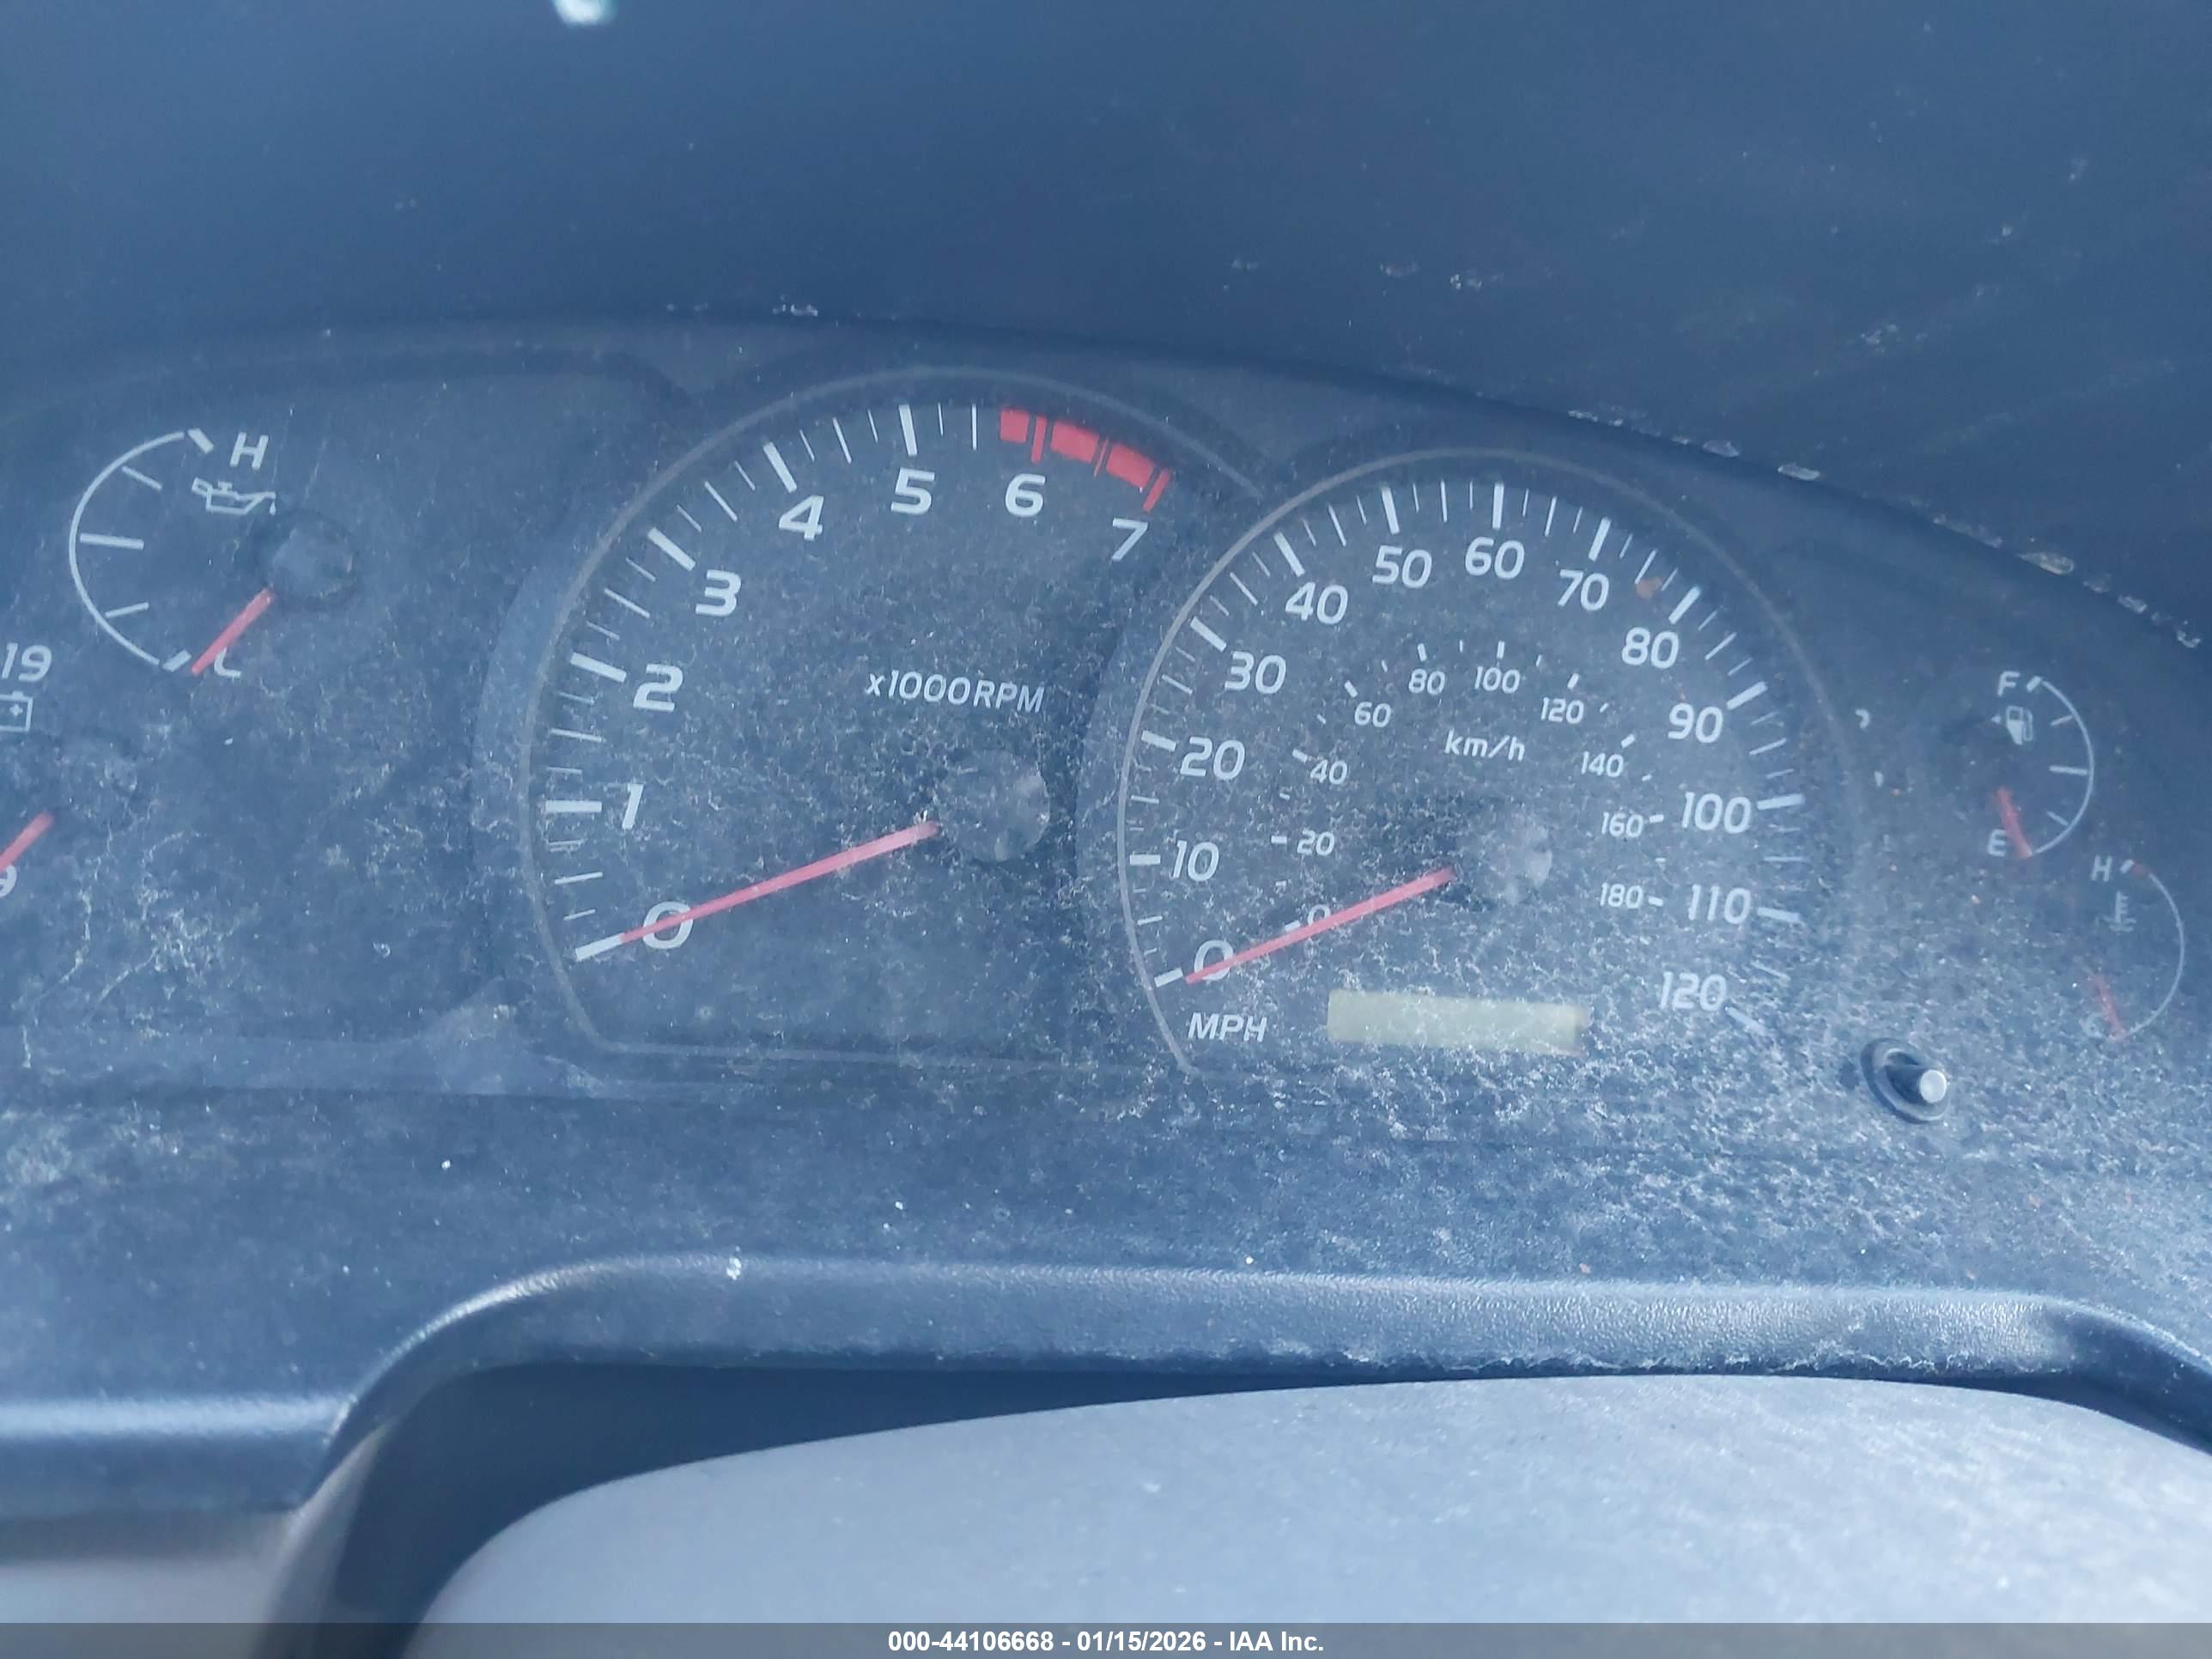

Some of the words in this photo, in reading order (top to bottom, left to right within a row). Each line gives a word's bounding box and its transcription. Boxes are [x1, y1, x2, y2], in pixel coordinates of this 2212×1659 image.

[229, 433, 269, 468] H
[890, 469, 935, 515] 5
[1005, 473, 1046, 515] 6
[779, 495, 826, 541] 4
[1112, 518, 1148, 562] 7
[1465, 537, 1525, 578] 60
[1372, 545, 1432, 588] 50
[696, 569, 742, 617] 3
[1285, 582, 1349, 624] 40
[1558, 568, 1609, 611] 70
[2, 642, 52, 682] 19
[1622, 628, 1679, 669] 80
[634, 664, 684, 711] 2
[1224, 651, 1286, 694] 30
[1407, 669, 1445, 695] 80
[1474, 665, 1521, 694] 100
[1997, 671, 2020, 696] F
[1354, 702, 1392, 727] 60
[1541, 697, 1585, 725] 120
[1668, 702, 1723, 744] 90
[1179, 737, 1246, 780] 20
[1444, 730, 1527, 763] km/h
[1581, 750, 1624, 778] 140
[1310, 758, 1349, 785] 40
[622, 783, 644, 830] 1
[1601, 811, 1644, 838] 160
[1680, 792, 1752, 834] 100
[1171, 839, 1220, 881] 10
[1297, 830, 1336, 857] 20
[1987, 829, 2008, 857] E
[2092, 856, 2112, 882] H
[1600, 882, 1644, 908] 180
[1687, 883, 1751, 925] 110
[643, 901, 694, 950] 0
[1194, 939, 1235, 981] 0
[1660, 970, 1728, 1012] 120
[1188, 1012, 1267, 1042] MPH
